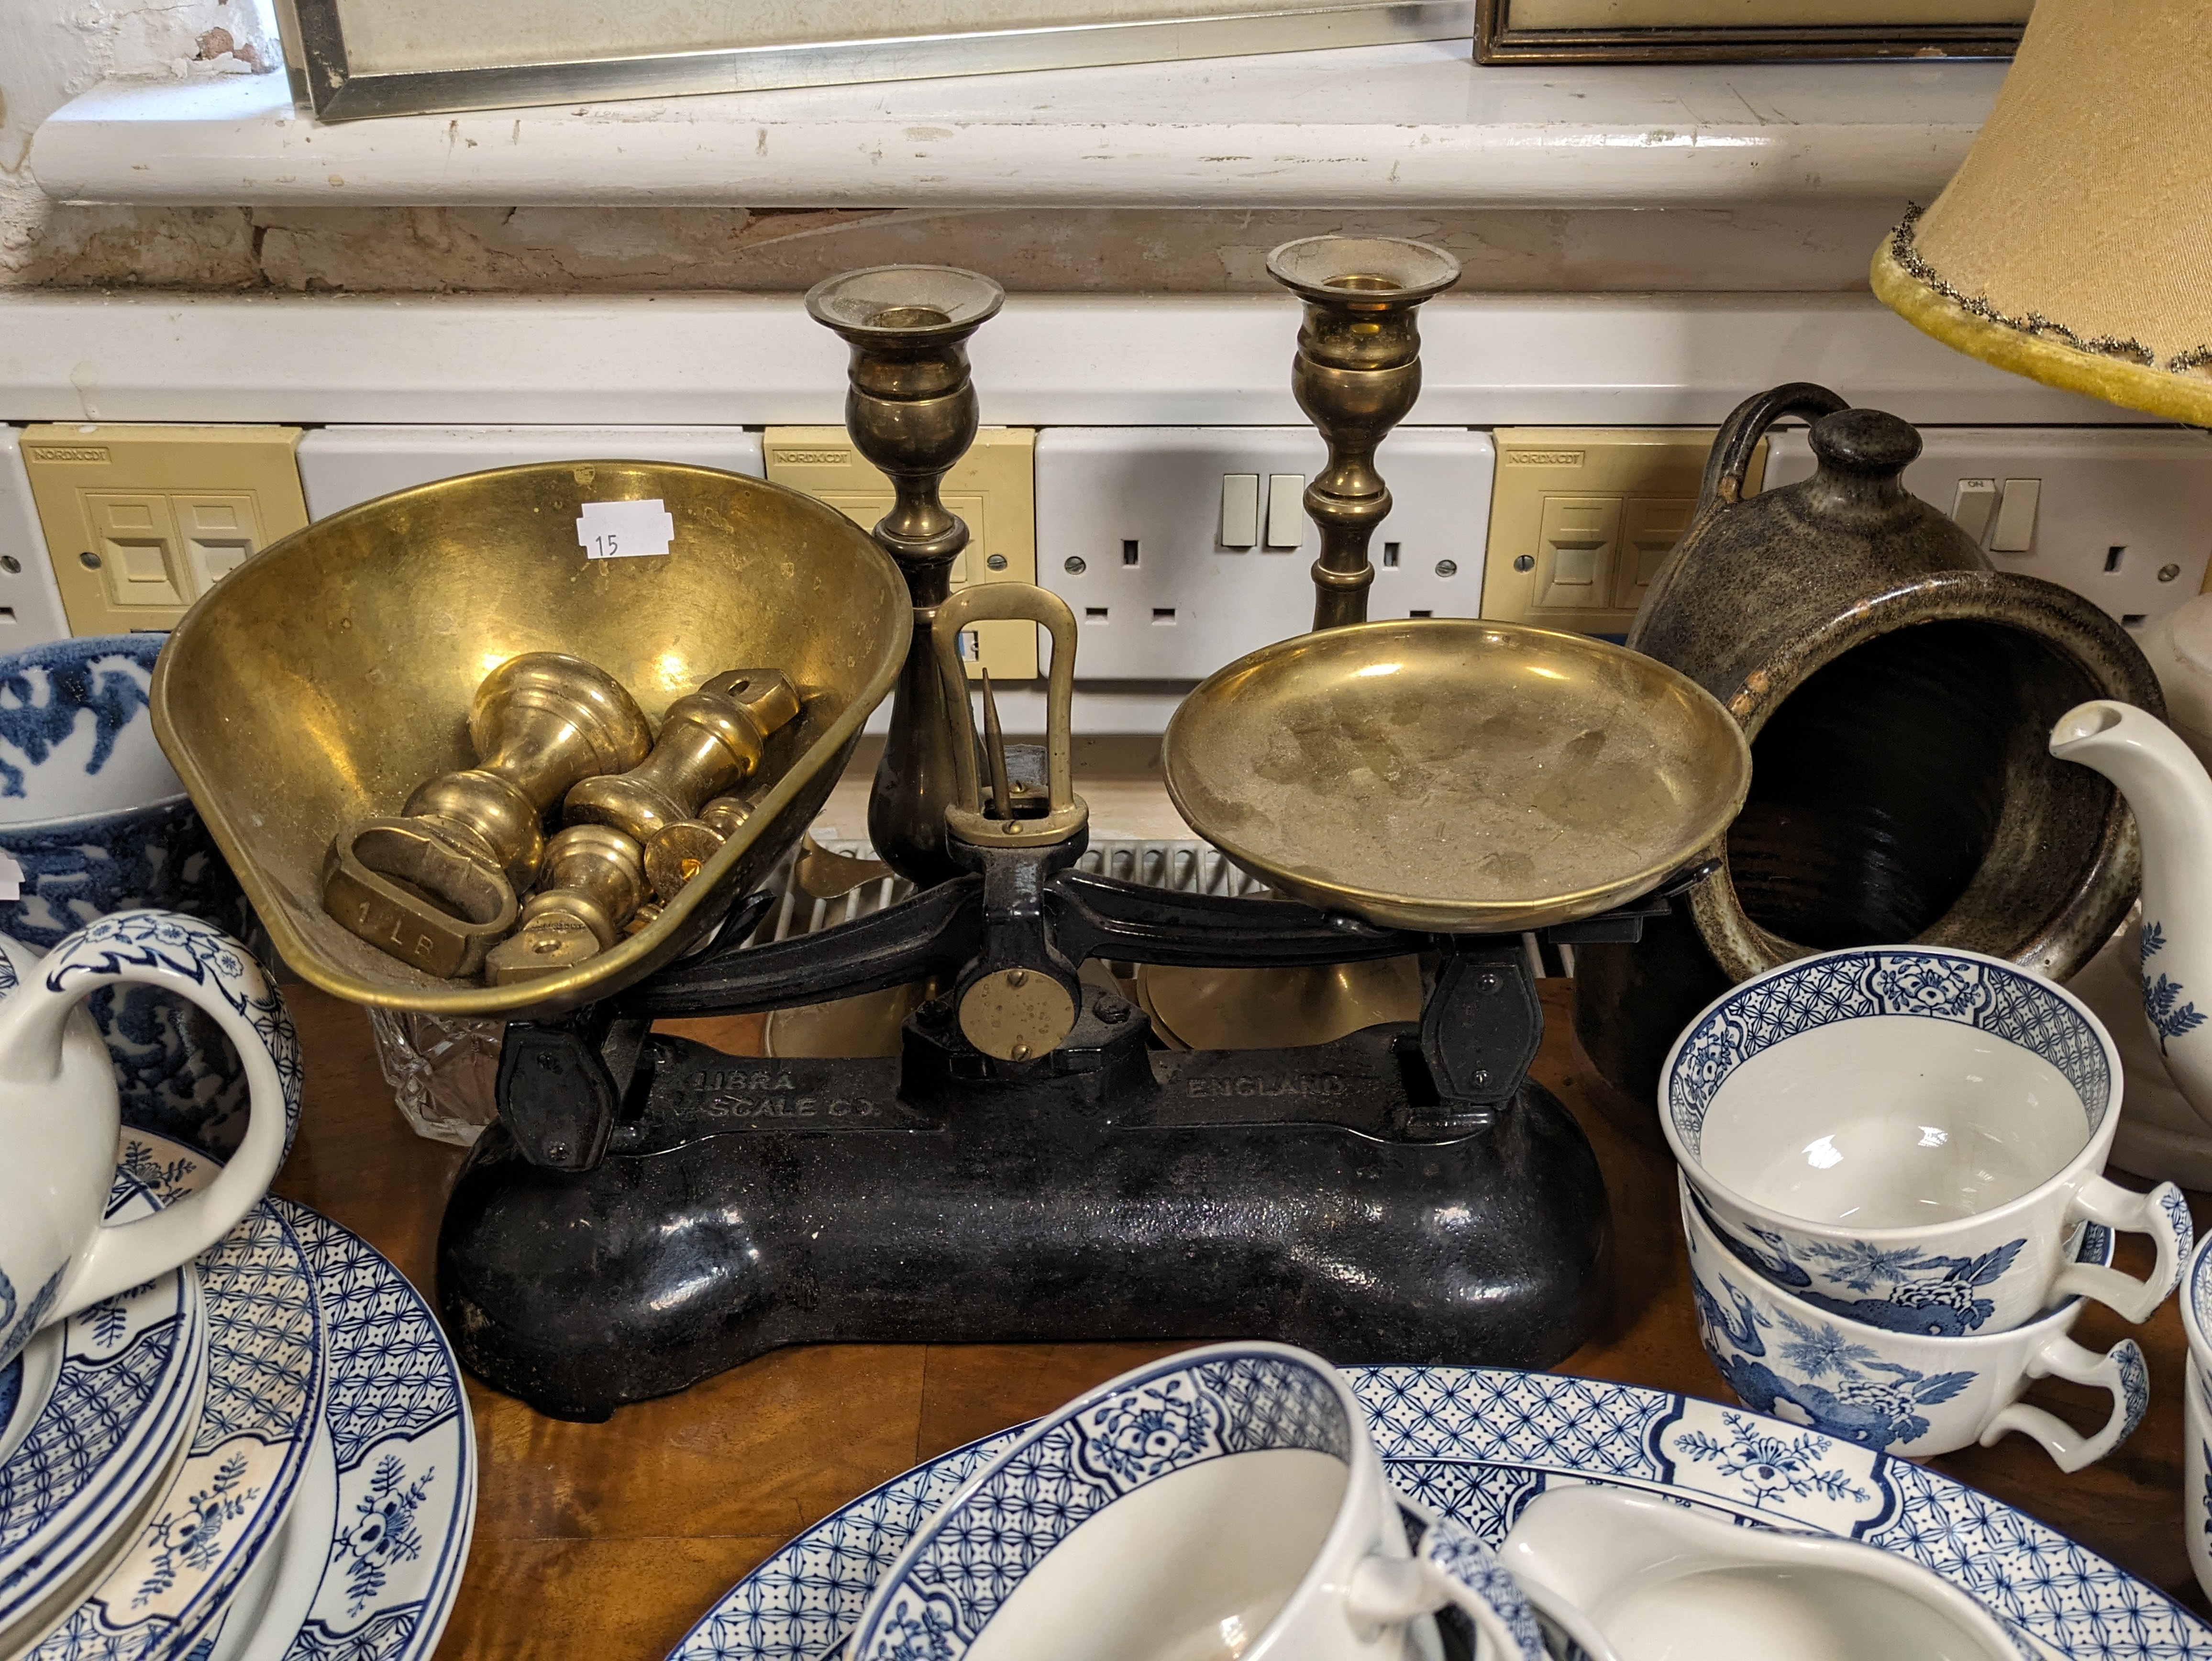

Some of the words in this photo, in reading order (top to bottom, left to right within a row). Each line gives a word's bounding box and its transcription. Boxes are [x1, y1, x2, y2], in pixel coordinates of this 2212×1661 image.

[596, 534, 618, 557] 15
[359, 901, 371, 924] 1
[390, 918, 433, 955] LB
[693, 1070, 796, 1091] LIBRA
[1186, 1075, 1347, 1097] ENGLAND
[707, 1096, 818, 1117] SCALE
